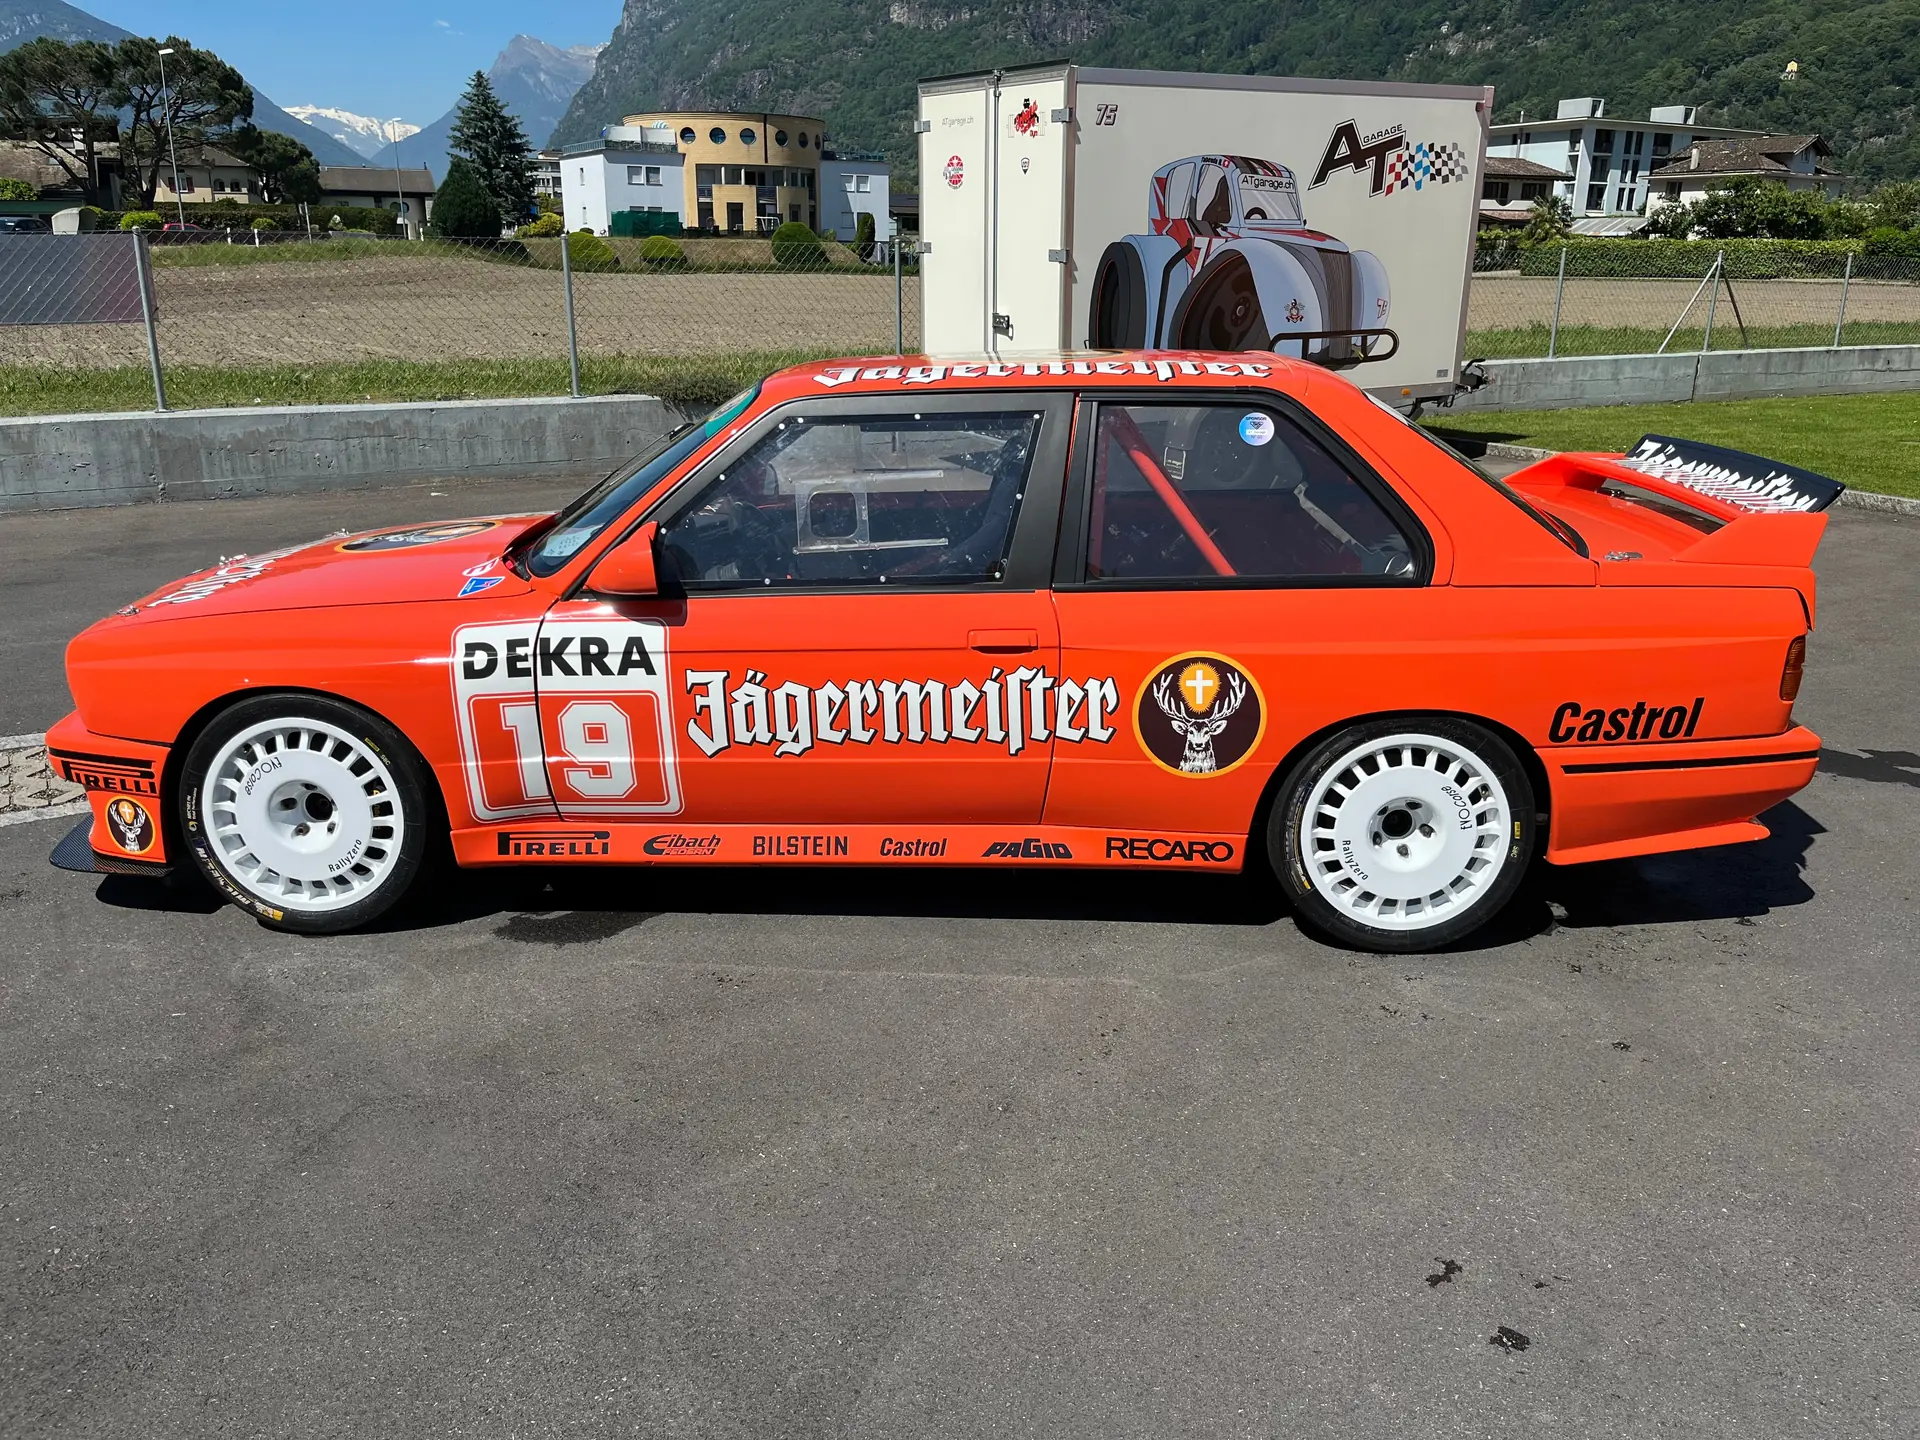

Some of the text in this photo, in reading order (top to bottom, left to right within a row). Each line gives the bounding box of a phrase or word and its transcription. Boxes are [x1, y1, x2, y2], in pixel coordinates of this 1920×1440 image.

[1096, 104, 1118, 126] 75
[1363, 124, 1403, 144] GARAGE
[1308, 118, 1406, 198] AT
[1241, 175, 1294, 190] ATgarage.ch
[463, 636, 657, 680] DEKRA
[1548, 697, 1705, 743] Castrol
[499, 700, 638, 801] 19
[61, 760, 158, 794] PIRELLI
[328, 838, 363, 873] RallyZero
[498, 831, 610, 856] PIRELLI
[643, 834, 721, 856] Eibach
[753, 836, 849, 856] BILSTEIN
[880, 838, 947, 857] Castrol
[1106, 837, 1234, 862] RECARO
[1342, 839, 1369, 881] RallyZero
